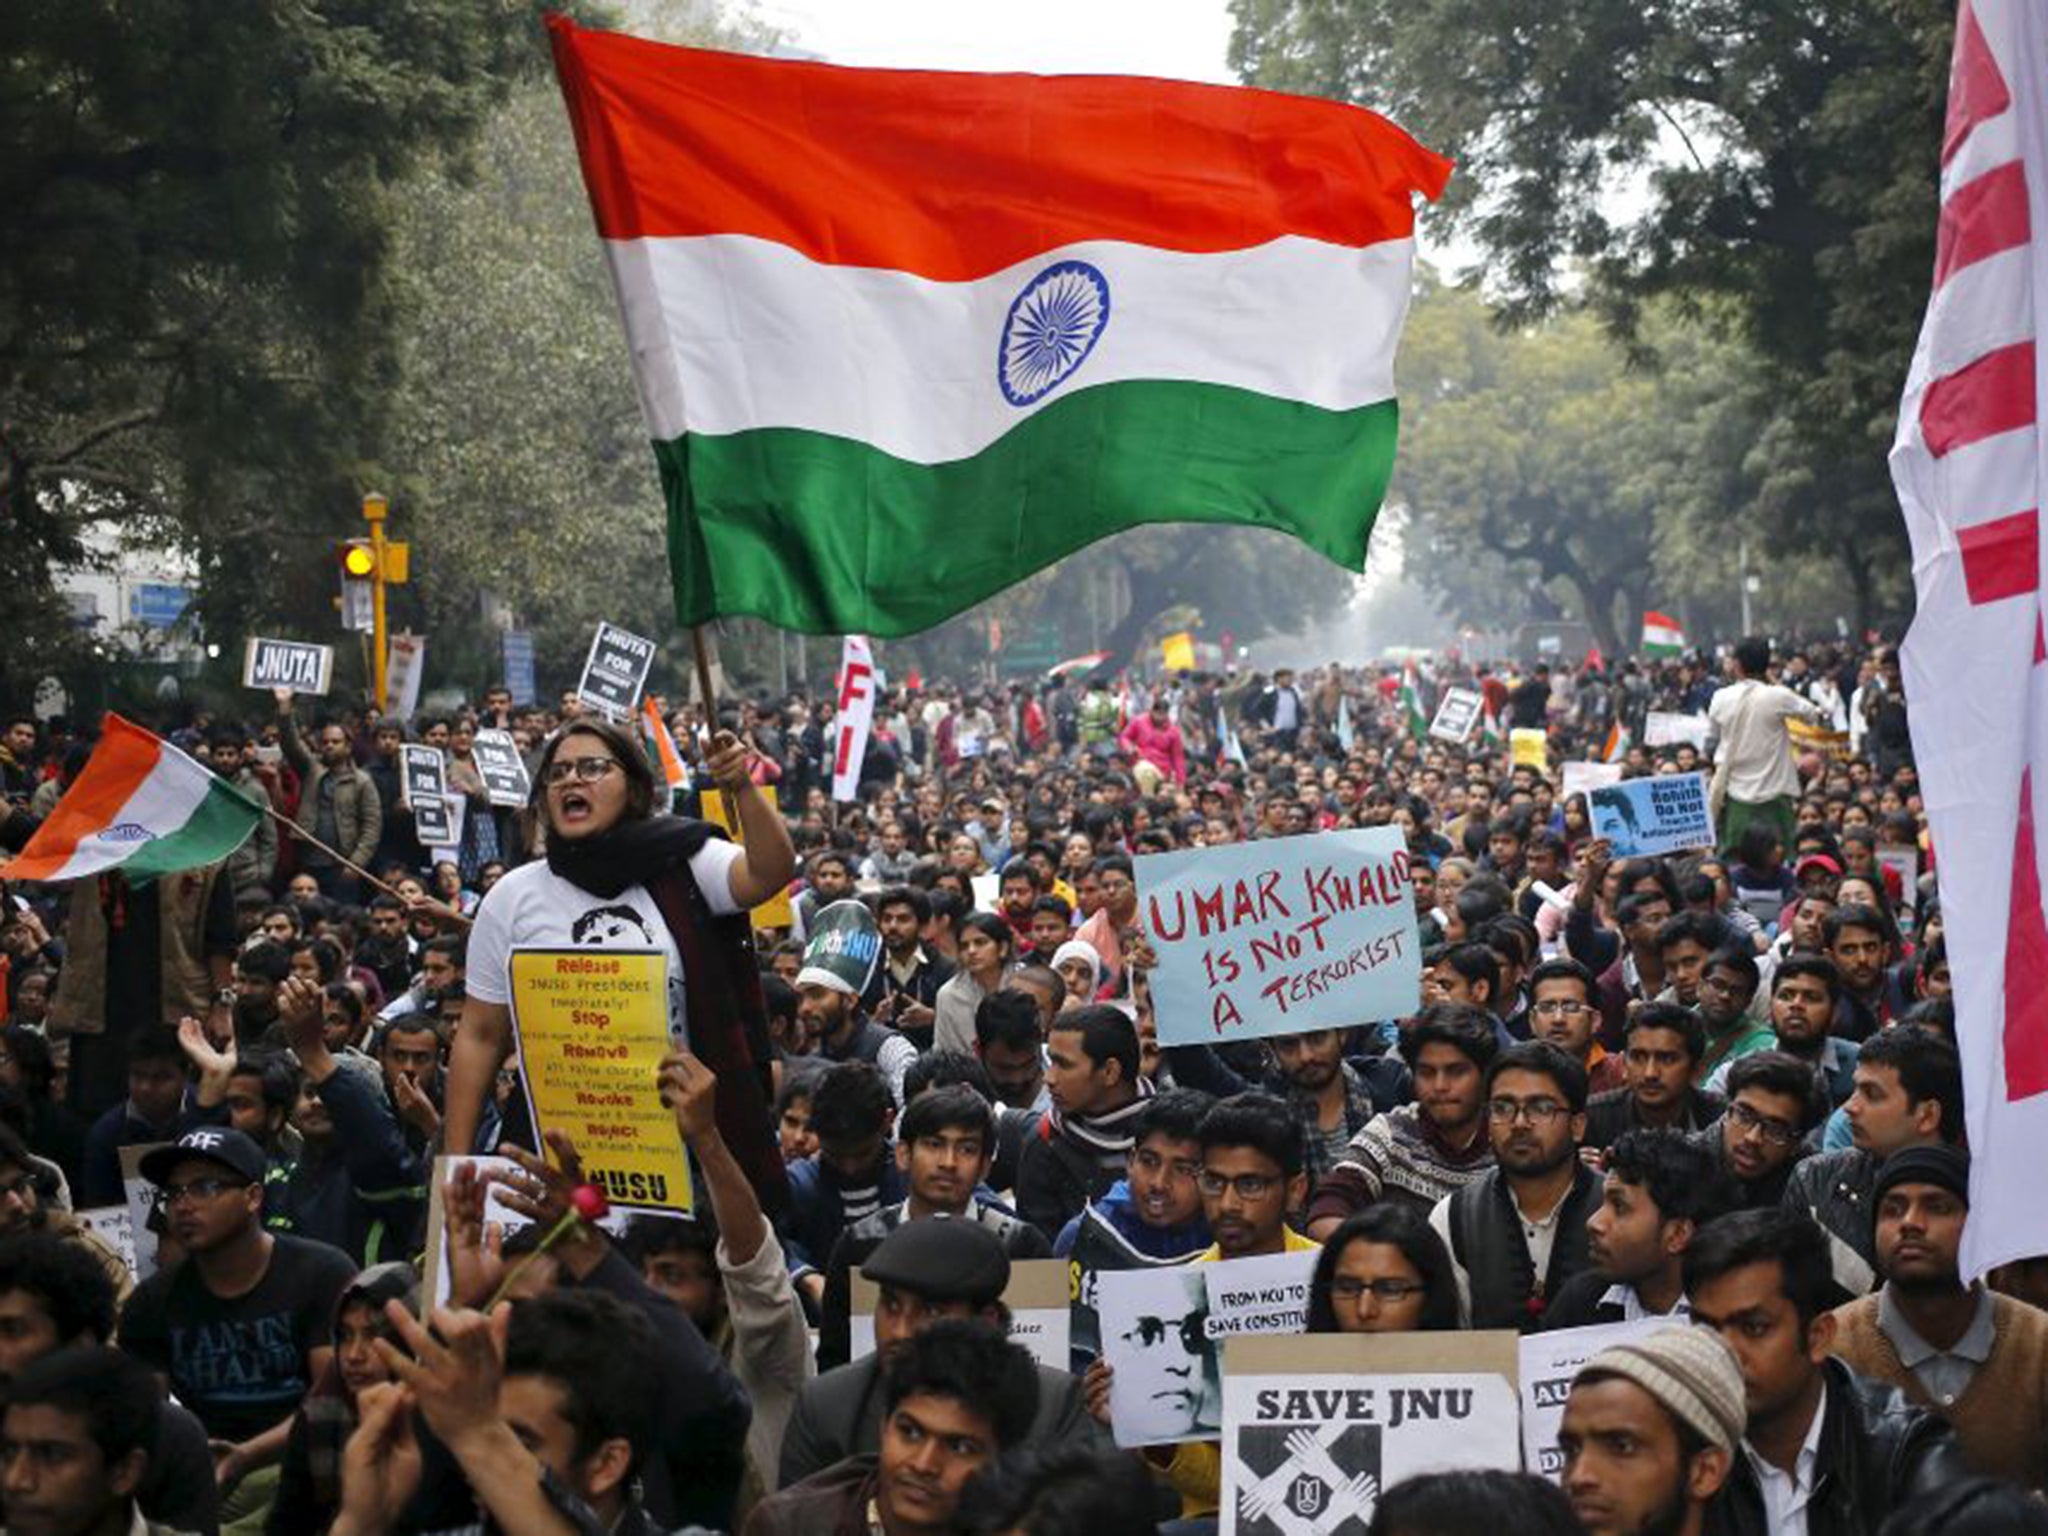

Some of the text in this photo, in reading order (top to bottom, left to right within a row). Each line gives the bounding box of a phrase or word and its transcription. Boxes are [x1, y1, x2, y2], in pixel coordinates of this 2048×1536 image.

[256, 645, 316, 684] JNUTA
[604, 651, 633, 674] FOR
[1150, 869, 1290, 941] UMAR
[1202, 915, 1330, 989] IS NOT
[556, 958, 621, 974] Release
[1213, 929, 1408, 1035] A TERRORIST
[572, 1010, 610, 1030] Stop
[563, 1043, 629, 1059] Remove
[576, 1091, 635, 1107] Revoke
[589, 1169, 669, 1202] NUSU
[1220, 1292, 1258, 1309] FROM
[1286, 1284, 1305, 1300] TO
[1208, 1311, 1308, 1334] SAVE CONSTITU
[1256, 1389, 1473, 1428] SAVE JNU
